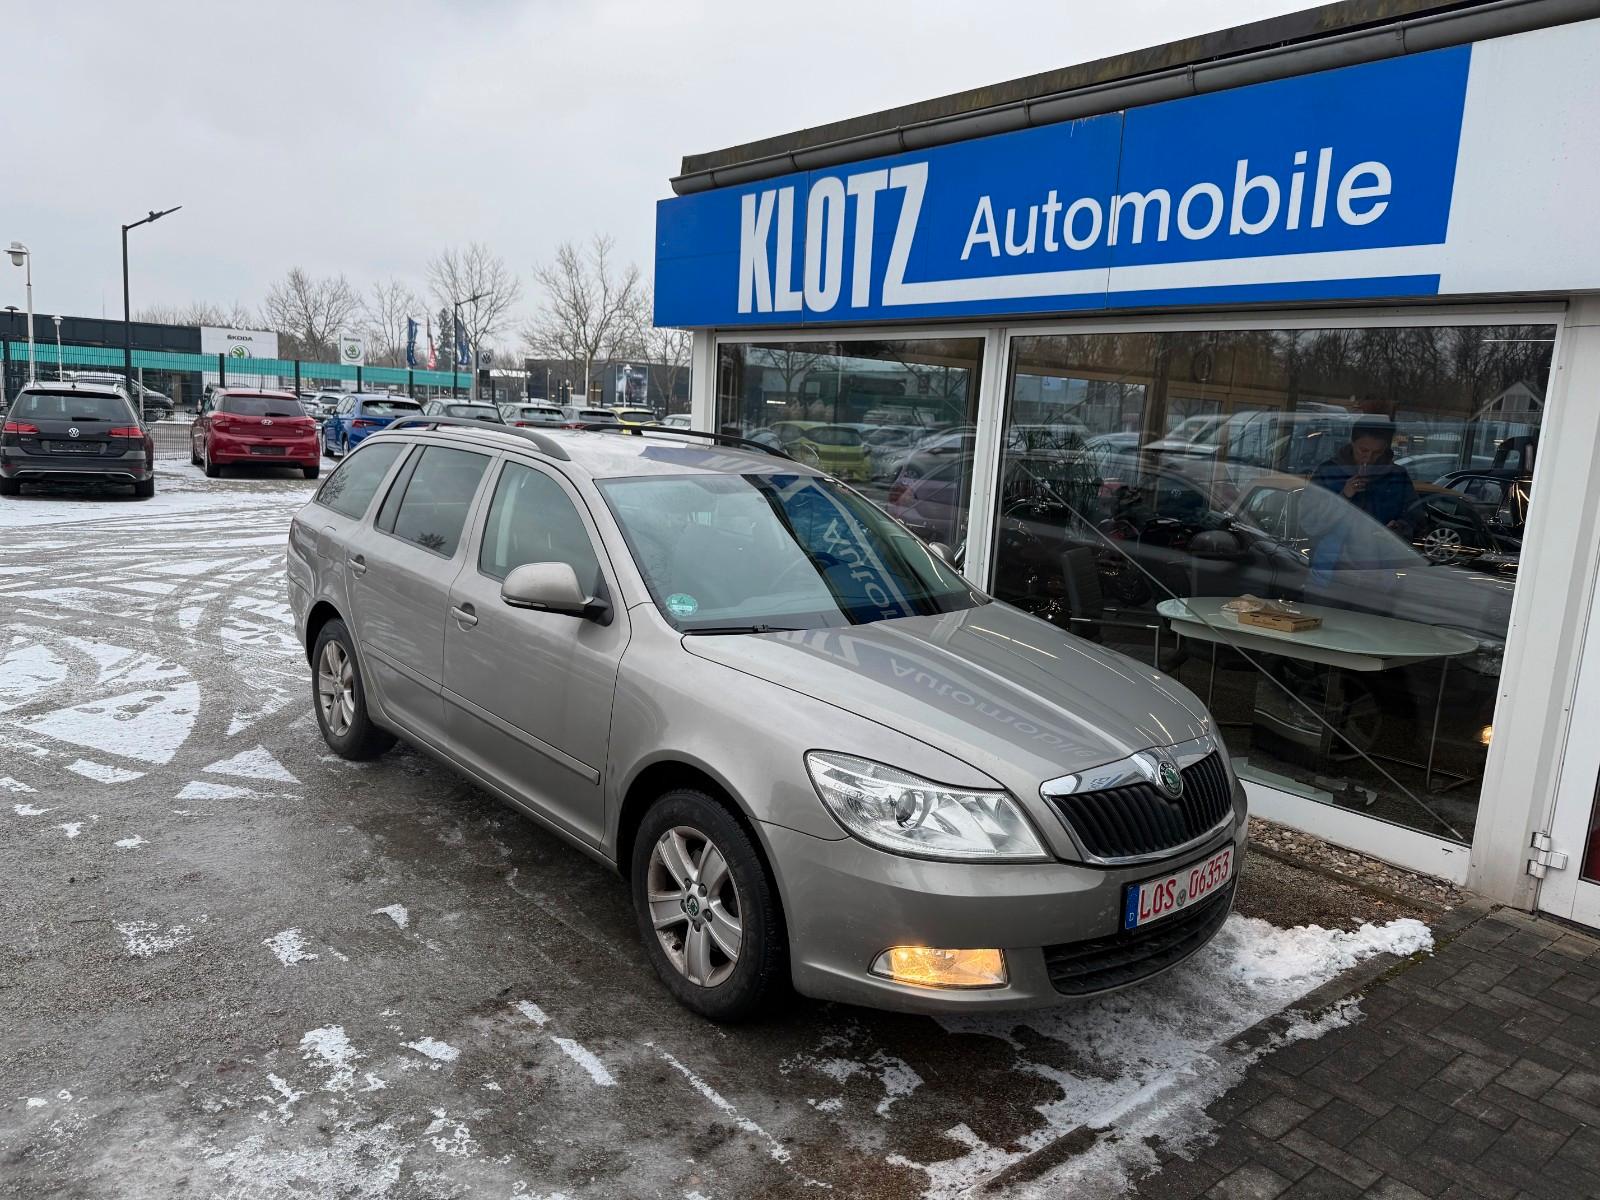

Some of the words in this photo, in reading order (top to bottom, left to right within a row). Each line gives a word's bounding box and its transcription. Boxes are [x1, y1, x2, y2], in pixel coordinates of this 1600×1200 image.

[736, 161, 930, 315] KLOTZ
[960, 147, 1393, 262] Automobile
[1139, 878, 1177, 920] LOS
[1188, 850, 1230, 899] 06353
